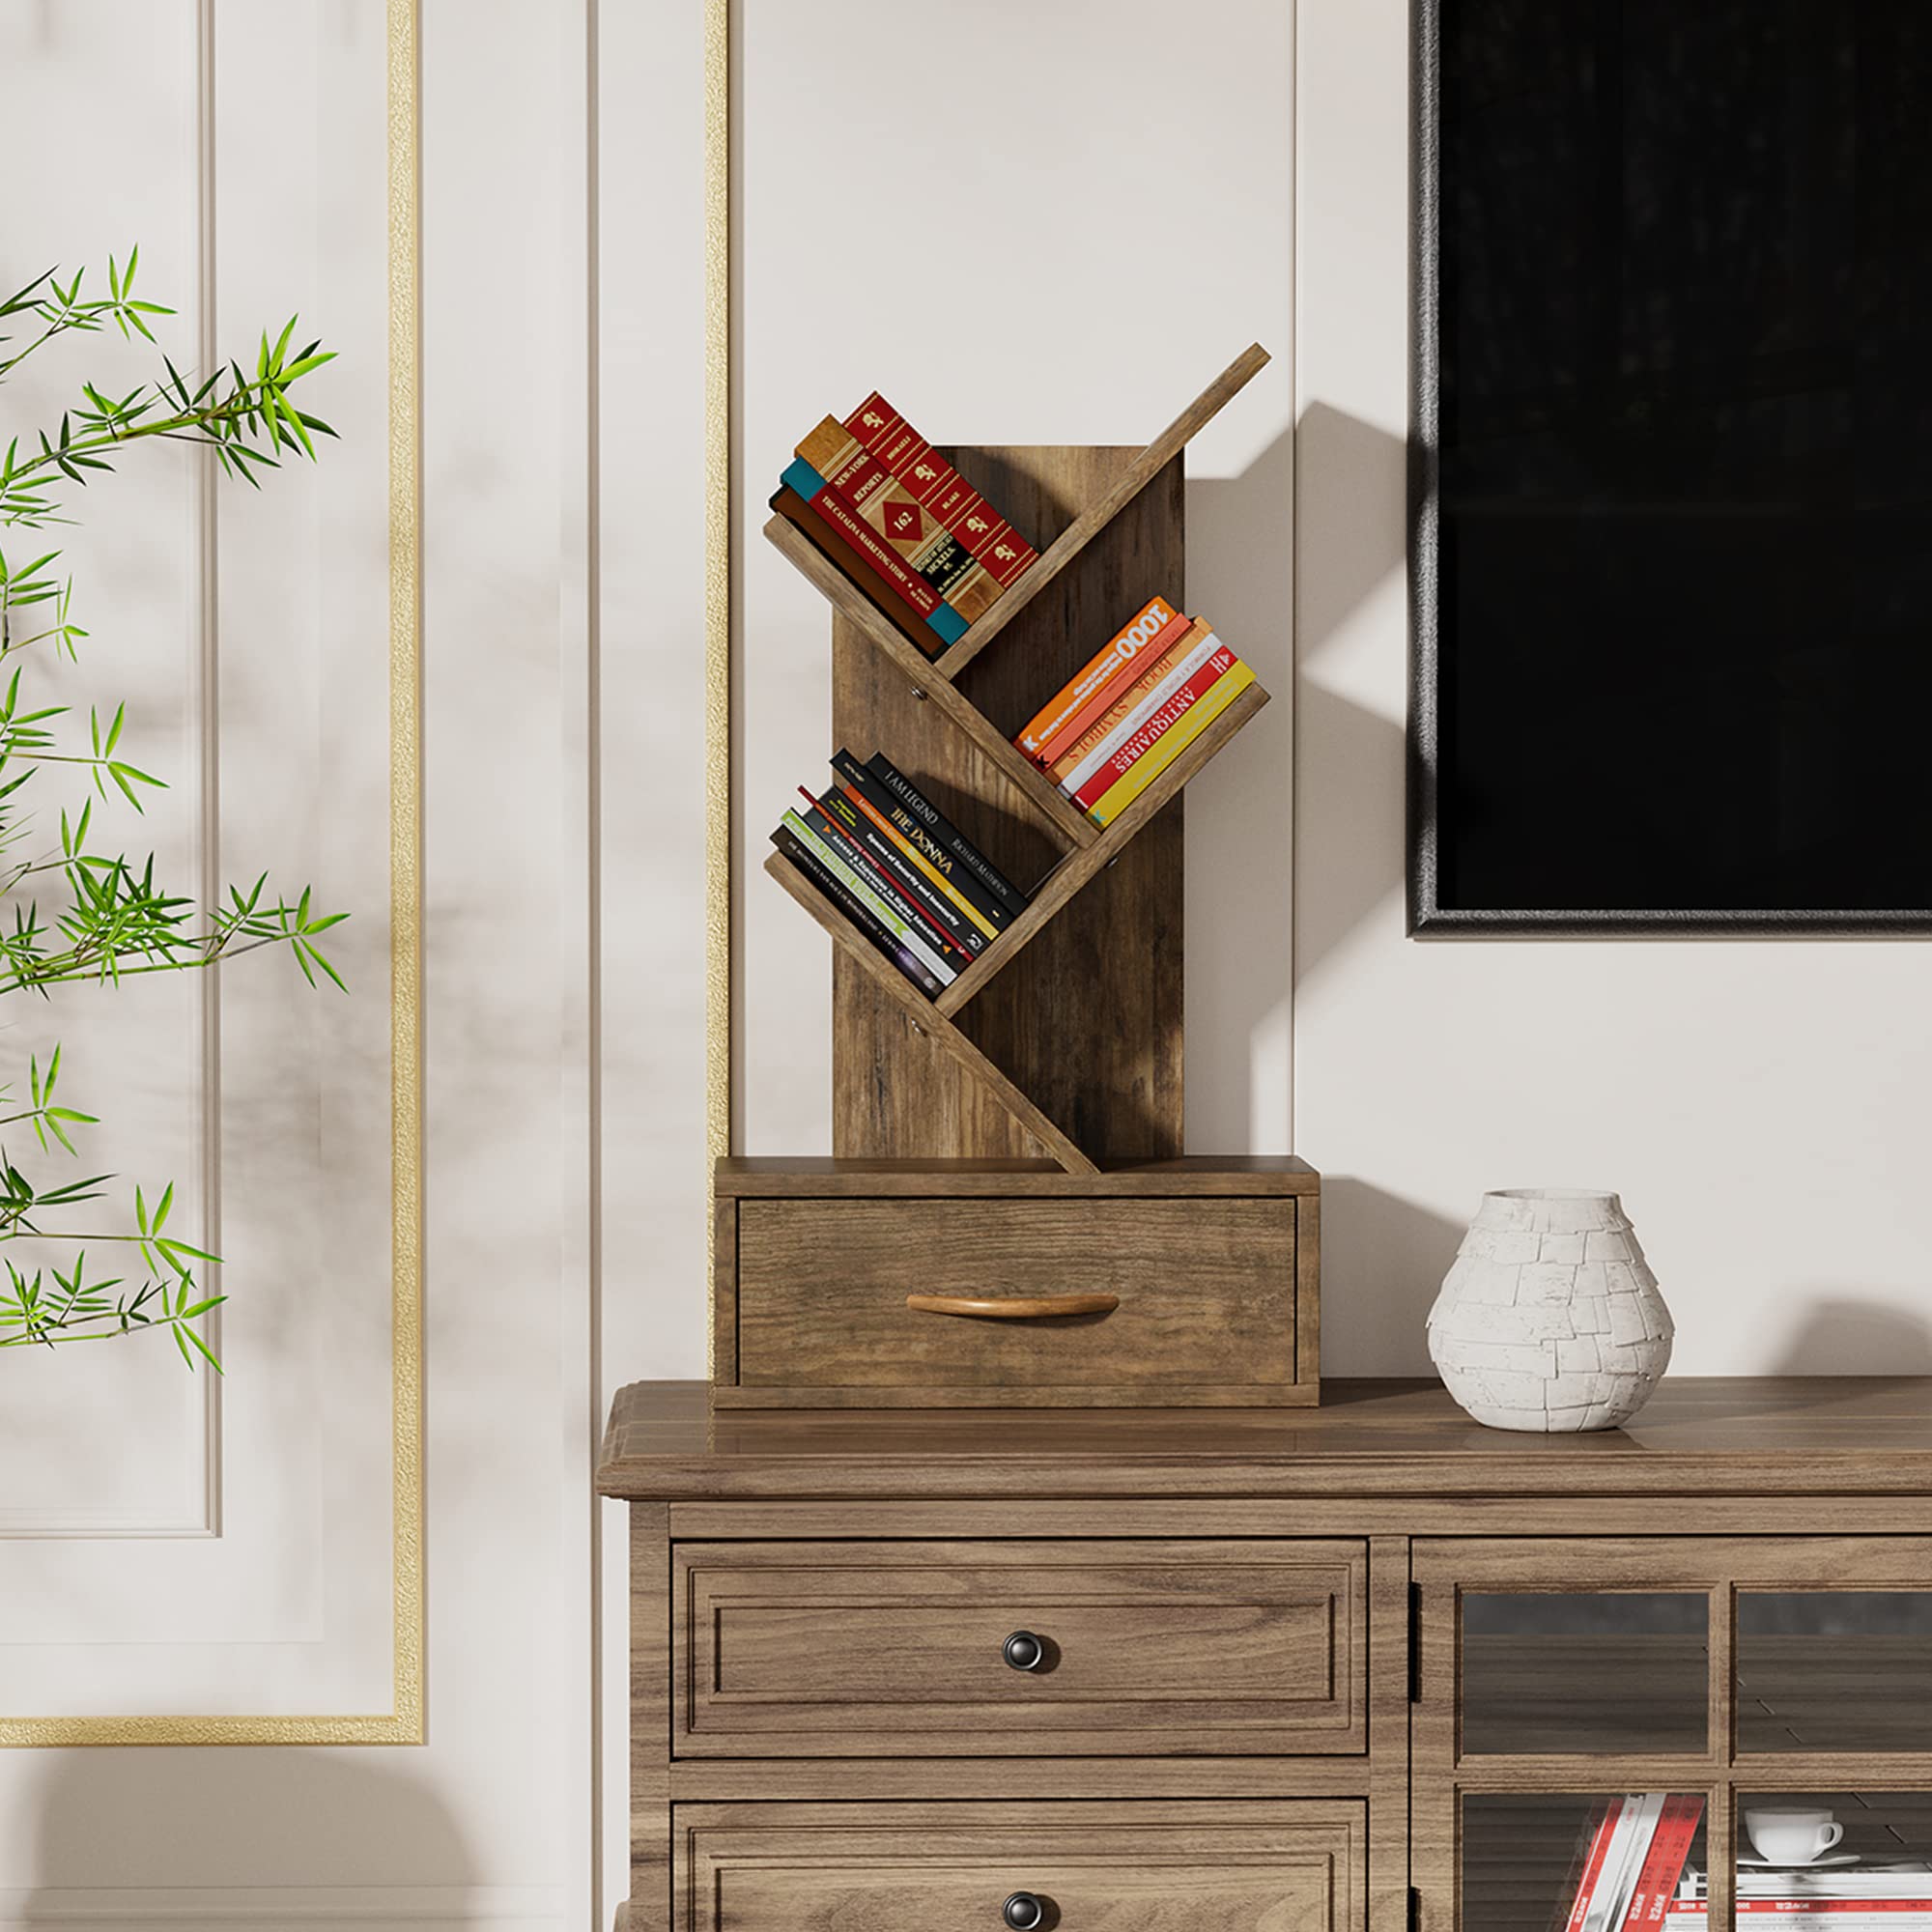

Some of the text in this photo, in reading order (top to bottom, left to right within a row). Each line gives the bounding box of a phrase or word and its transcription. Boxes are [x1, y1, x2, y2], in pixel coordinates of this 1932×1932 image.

[852, 470, 885, 502] REPORTS
[820, 495, 836, 510] THE
[830, 505, 862, 537] CATALINA
[856, 531, 893, 567] MARKETING
[887, 561, 909, 583] STORY
[891, 509, 915, 532] 162
[1111, 602, 1171, 662] 1000
[1134, 656, 1174, 696] BOOK
[1113, 688, 1198, 774] ANTIQUAIRES
[883, 769, 895, 781] I
[887, 774, 909, 795] AM
[886, 804, 916, 833] THE
[901, 787, 941, 827] LEGEND
[885, 852, 897, 864] of
[891, 858, 921, 888] Security
[916, 882, 932, 898] and
[925, 894, 961, 928] Insecurity
[892, 895, 915, 918] Higher
[911, 913, 944, 946] Education
